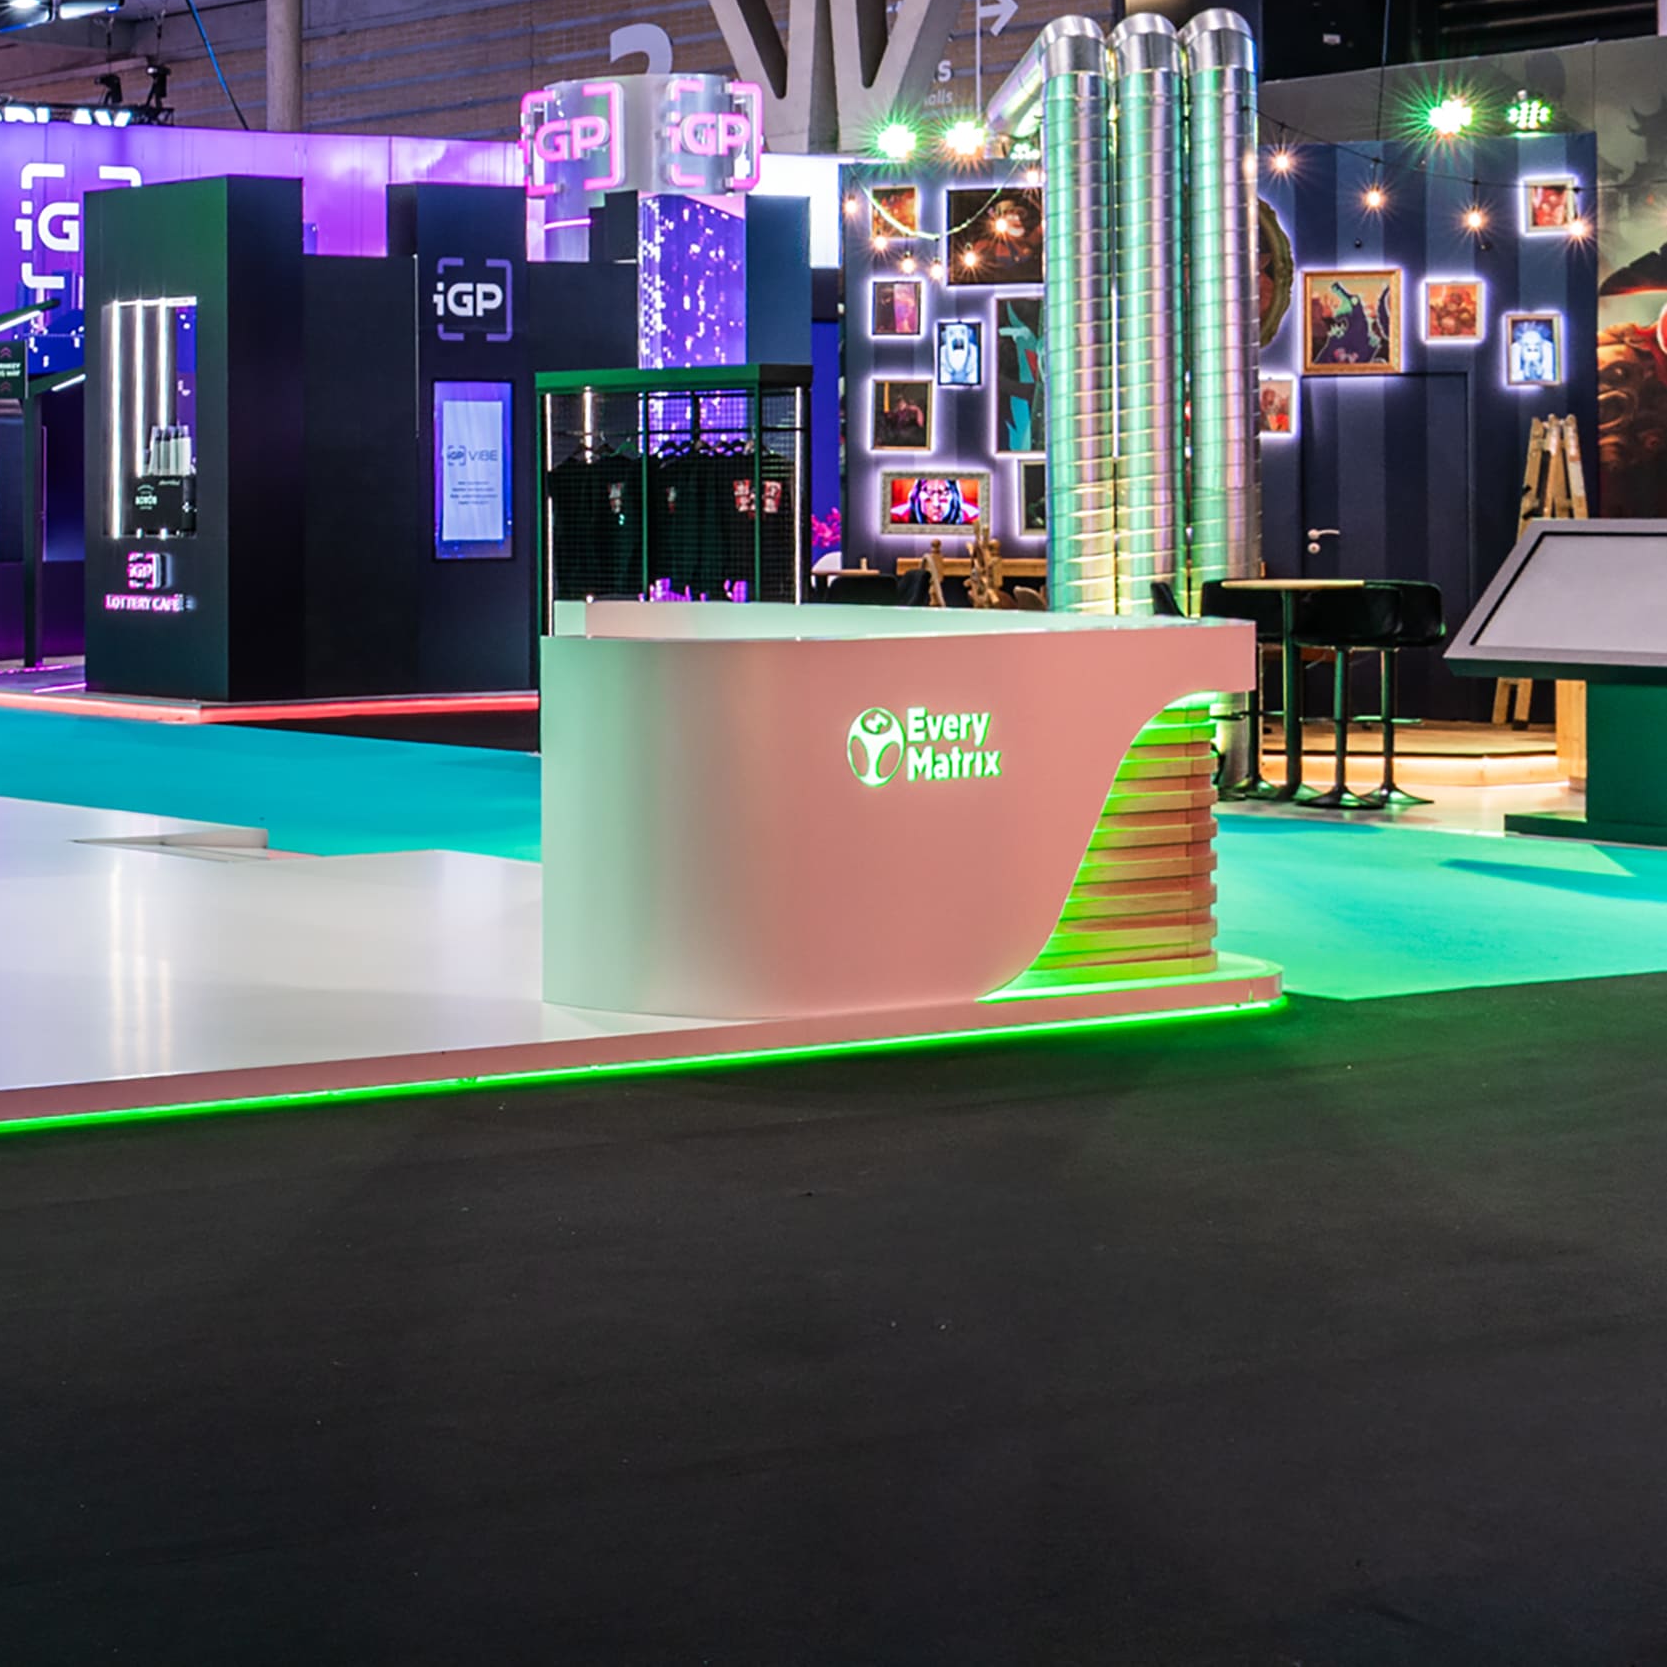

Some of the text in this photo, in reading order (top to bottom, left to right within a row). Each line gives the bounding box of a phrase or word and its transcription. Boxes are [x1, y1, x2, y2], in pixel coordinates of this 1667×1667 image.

[15, 199, 80, 252] iG
[433, 281, 503, 317] iGP
[907, 706, 991, 748] Every
[907, 745, 1002, 782] Matrix
